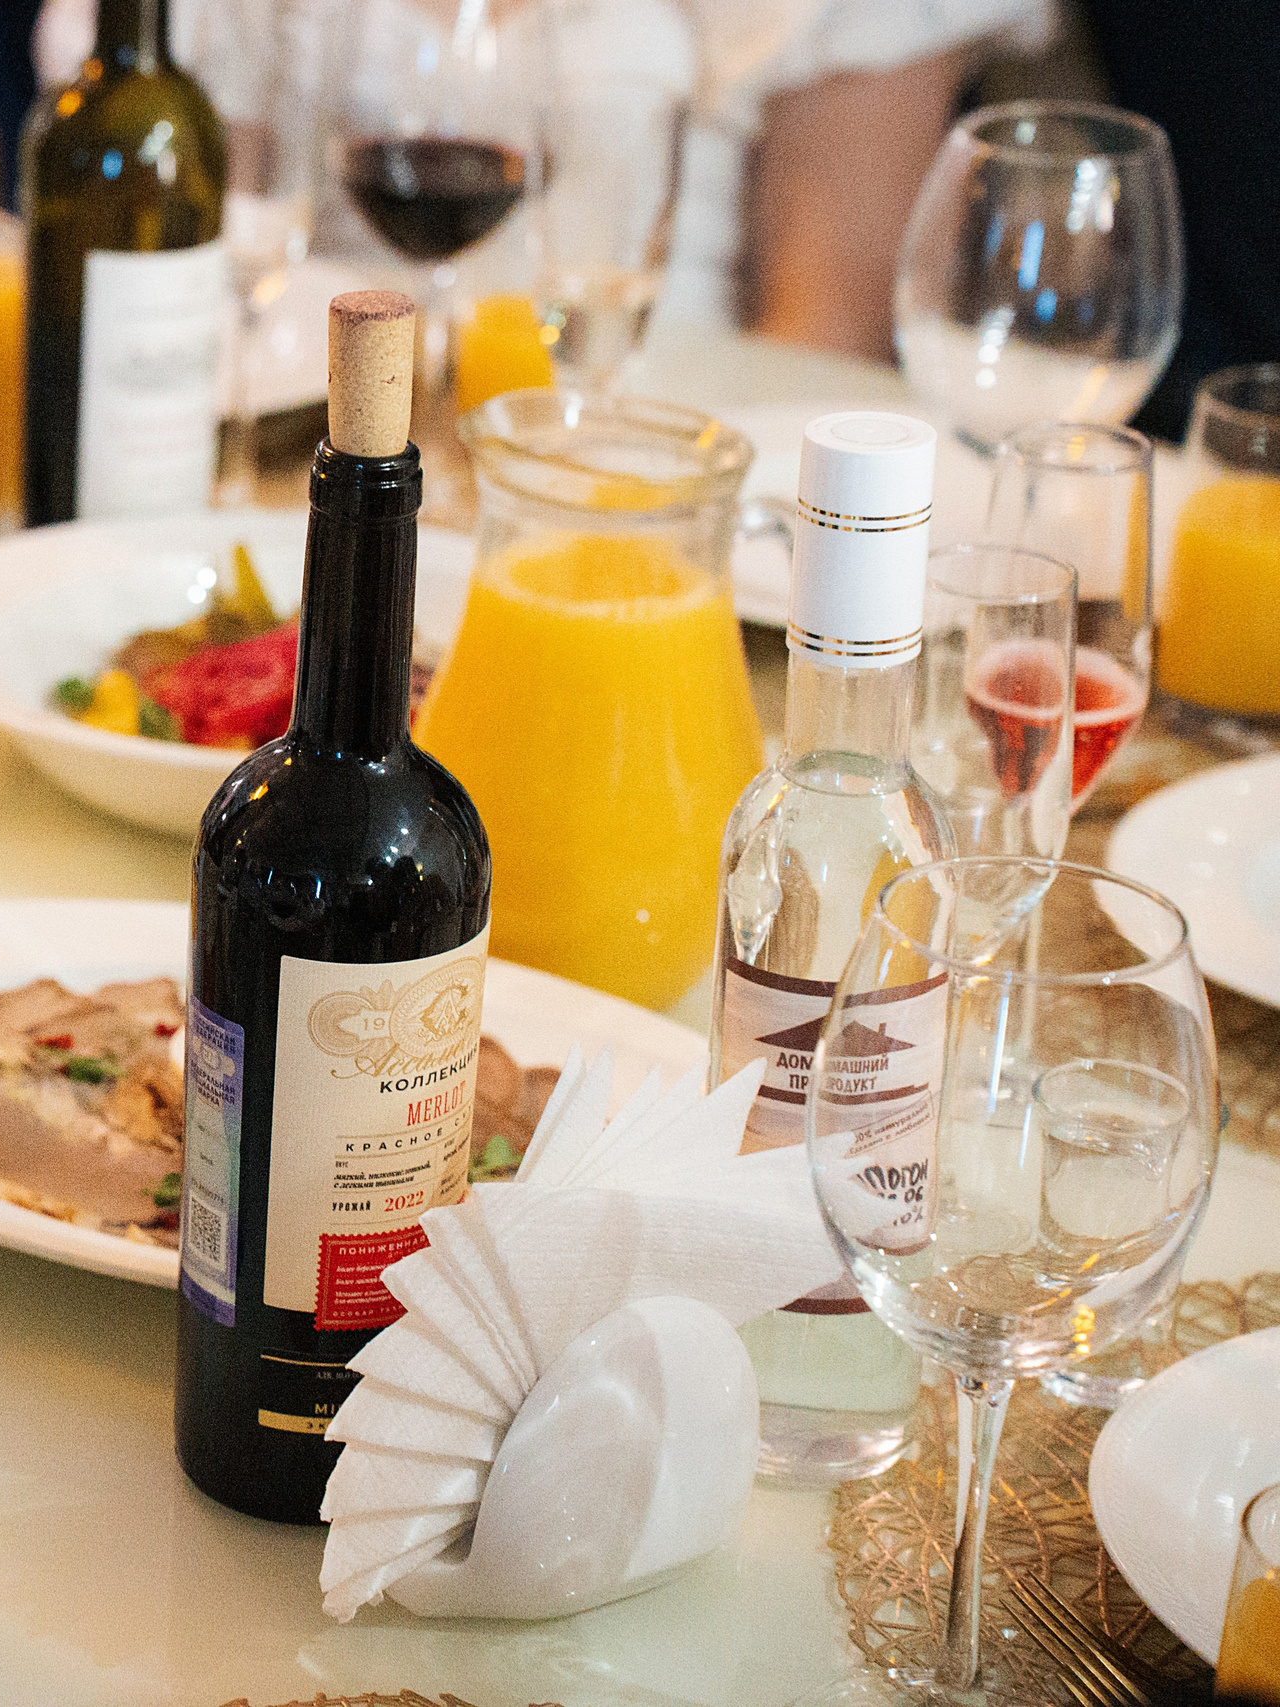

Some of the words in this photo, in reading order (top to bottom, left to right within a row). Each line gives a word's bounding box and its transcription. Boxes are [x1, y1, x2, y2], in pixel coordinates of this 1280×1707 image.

[362, 1017, 386, 1031] 19
[406, 1080, 466, 1127] MERLOT
[345, 1127, 443, 1152] КРАСНОЕ
[332, 1200, 372, 1212] УРОЖАЙ
[383, 1190, 425, 1213] 2022
